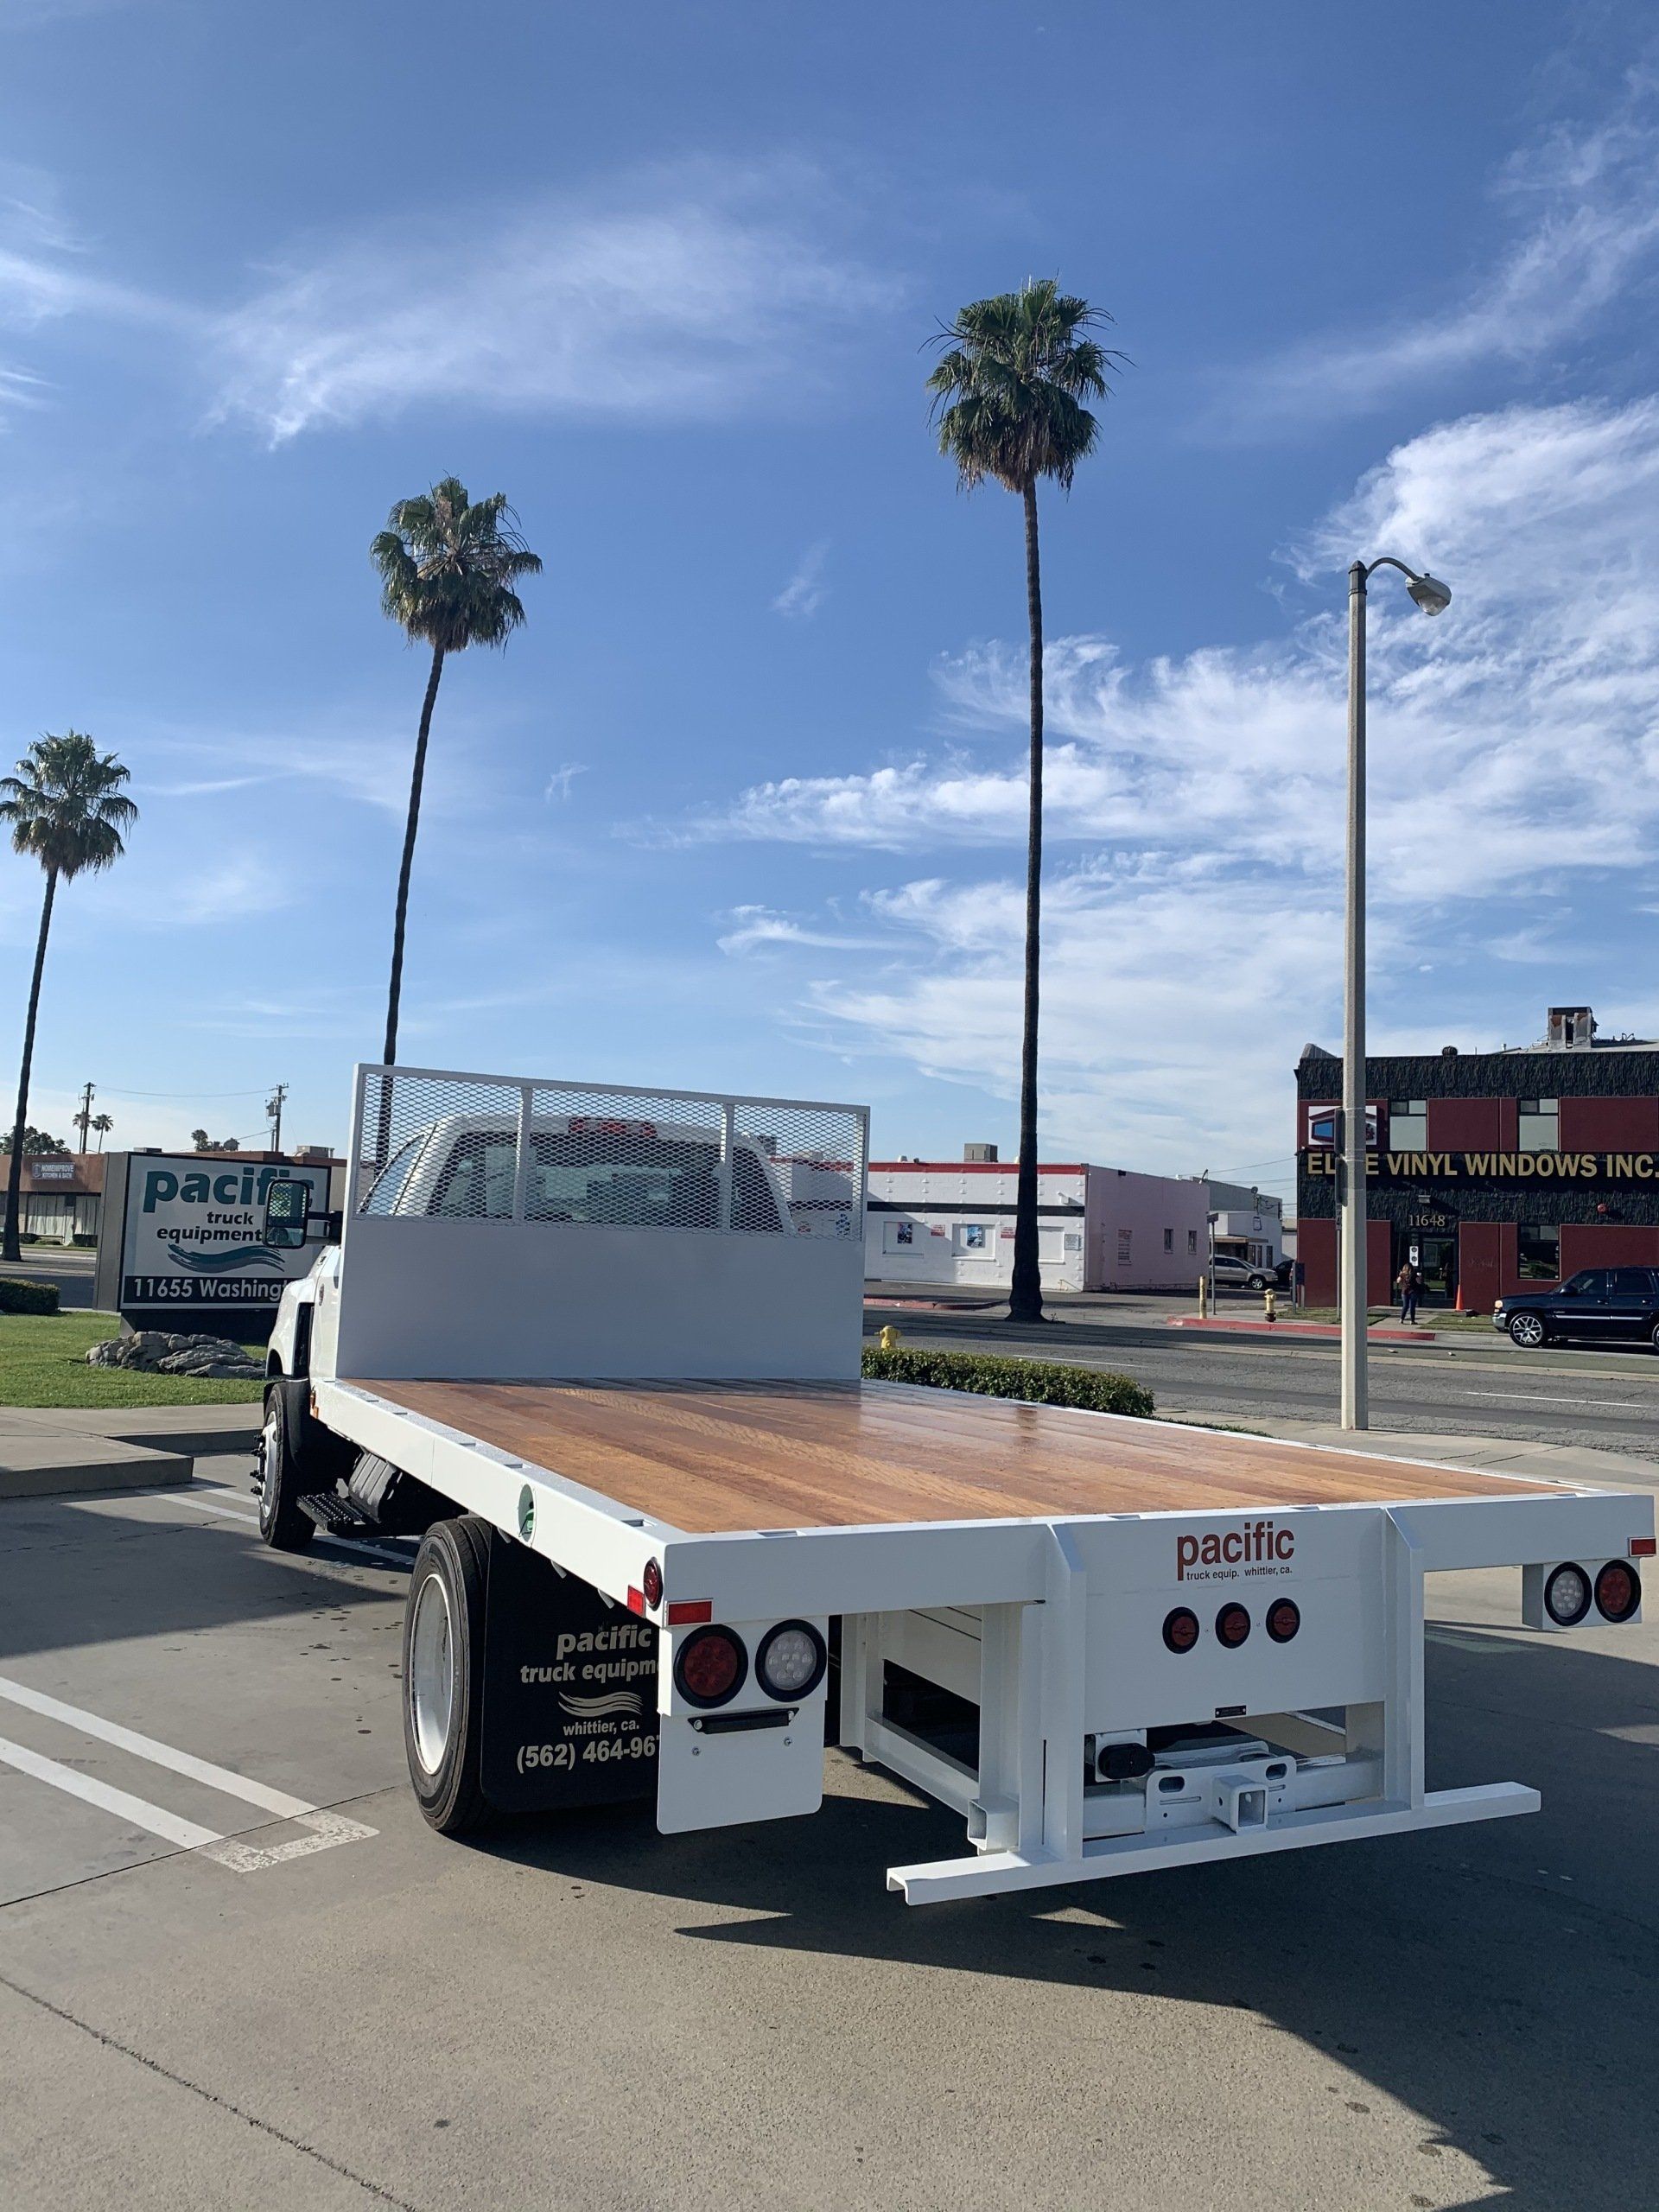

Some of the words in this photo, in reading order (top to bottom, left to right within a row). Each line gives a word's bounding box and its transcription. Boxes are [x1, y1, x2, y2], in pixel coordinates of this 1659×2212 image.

[1307, 1153, 1379, 1175] ELE
[1387, 1154, 1458, 1176] VINYL
[1465, 1154, 1598, 1177] WINDOWS
[1606, 1154, 1659, 1178] INC.
[207, 1211, 254, 1225] truck
[1409, 1214, 1446, 1227] 11648
[156, 1226, 263, 1244] equipment
[134, 1278, 193, 1298] 11655
[1177, 1521, 1294, 1580] pacific
[1186, 1570, 1210, 1580] truck
[1212, 1568, 1239, 1580] equip.
[1244, 1566, 1278, 1576] whittier,
[1280, 1566, 1293, 1574] ca.
[556, 1624, 652, 1660] pacific
[520, 1662, 575, 1683] truck
[582, 1658, 659, 1683] equipm
[563, 1719, 617, 1736] whittier,
[620, 1719, 640, 1731] ca.
[517, 1743, 575, 1774] (562)
[582, 1735, 660, 1763] 464-96
